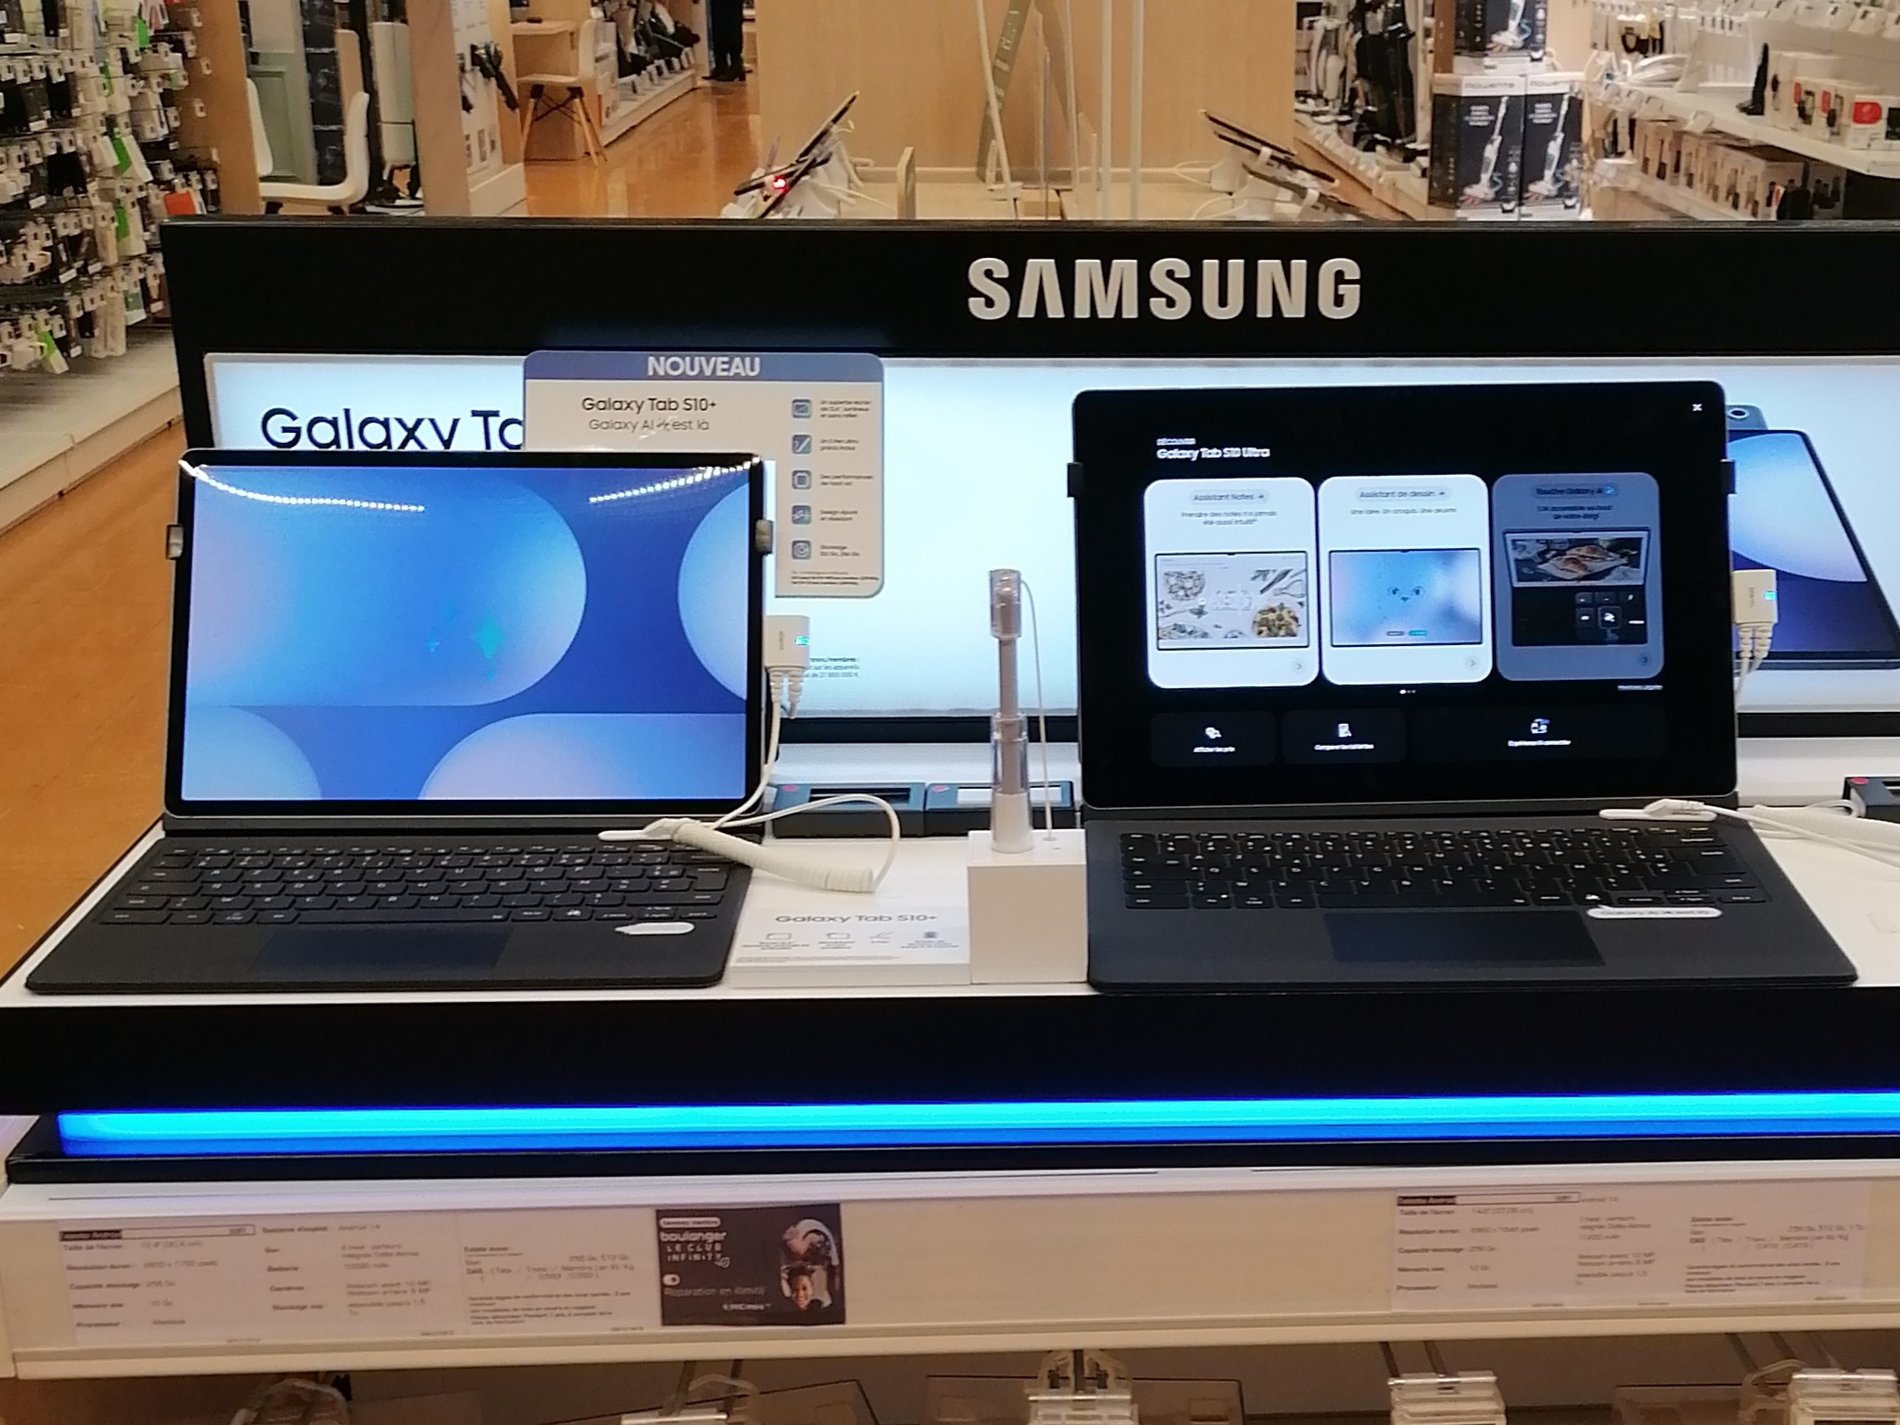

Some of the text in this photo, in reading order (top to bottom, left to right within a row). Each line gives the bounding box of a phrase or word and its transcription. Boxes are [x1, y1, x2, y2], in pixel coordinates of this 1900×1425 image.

[967, 257, 1363, 321] SAMSUNG
[647, 356, 761, 378] NOUVEAU
[582, 397, 717, 415] Galaxy Tab S10+
[261, 407, 461, 449] Galaxy
[588, 418, 710, 433] Galaxy AI est là
[1156, 448, 1199, 461] Galaxy
[1200, 447, 1222, 459] Tab
[1242, 447, 1271, 458] Ultra
[775, 914, 937, 923] Galaxy Tab S10+
[660, 1231, 728, 1243] boulanger
[687, 1242, 723, 1252] CLUB
